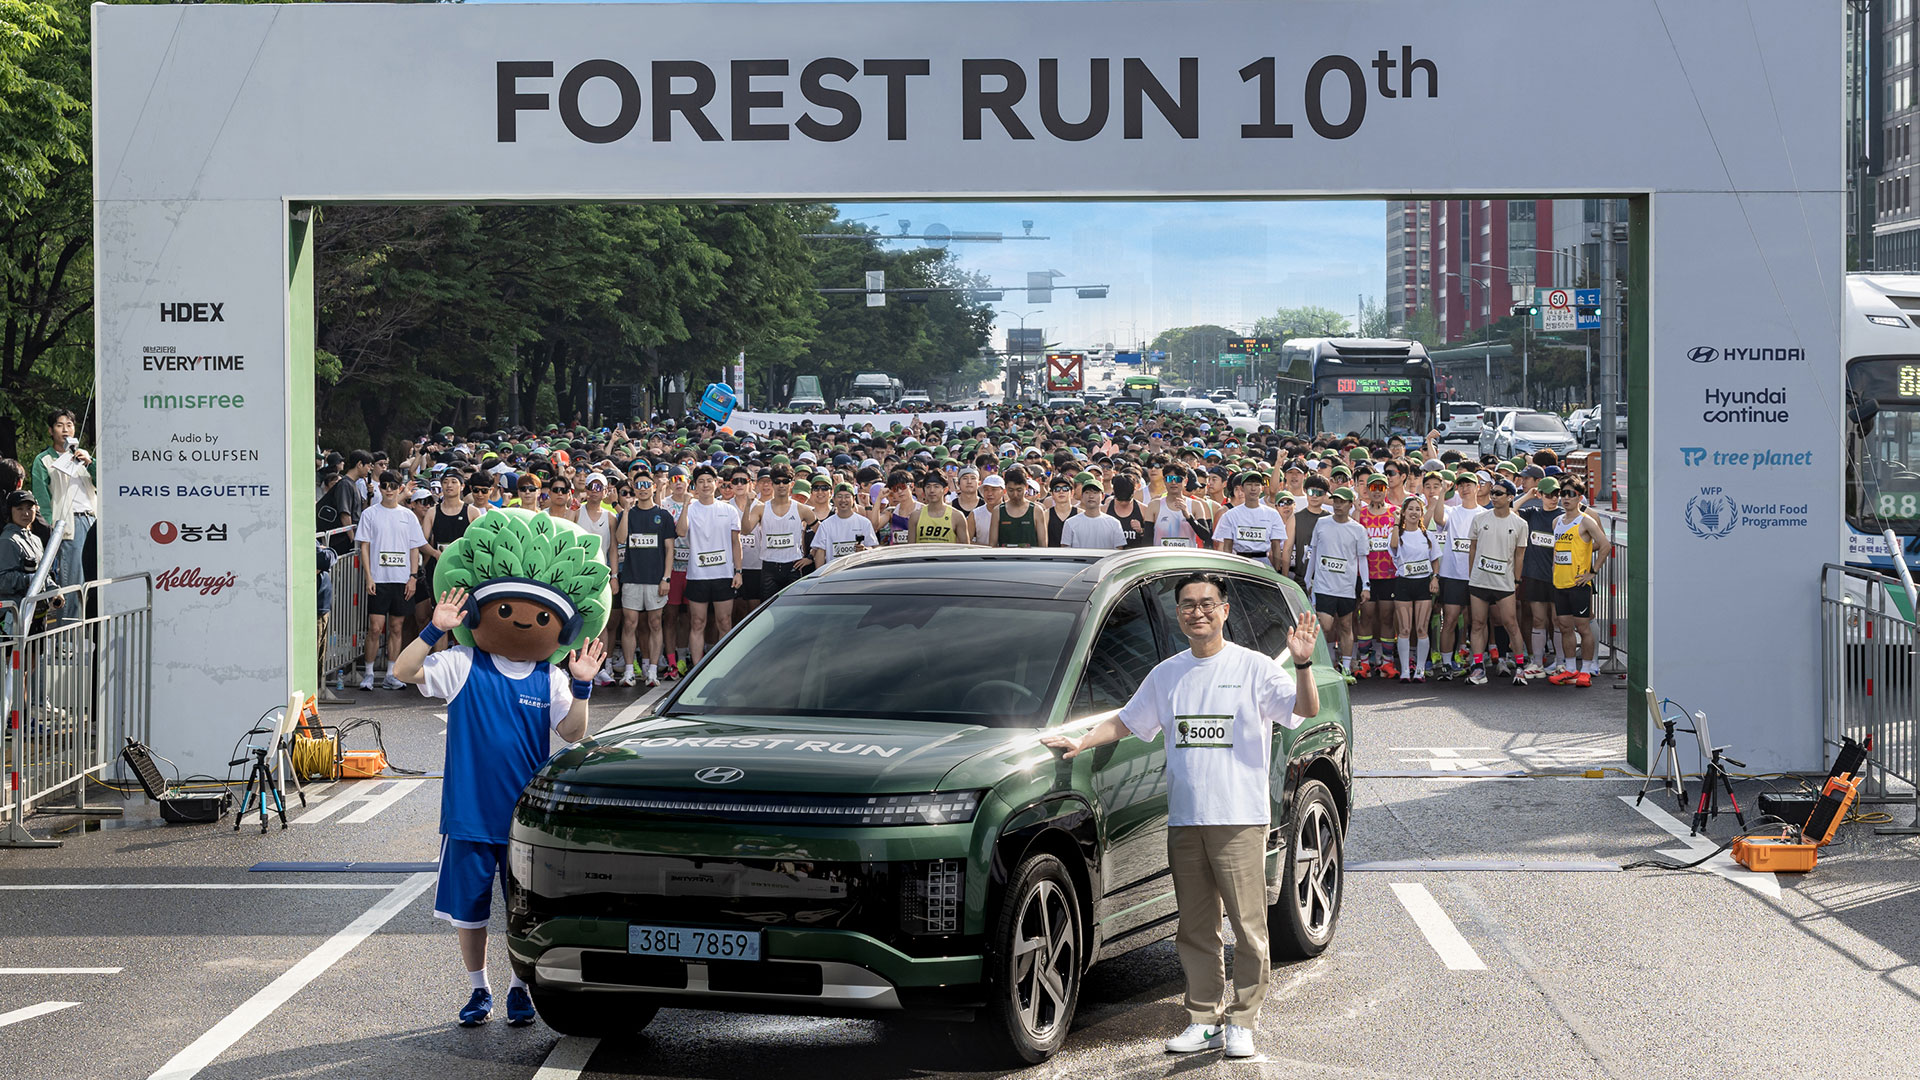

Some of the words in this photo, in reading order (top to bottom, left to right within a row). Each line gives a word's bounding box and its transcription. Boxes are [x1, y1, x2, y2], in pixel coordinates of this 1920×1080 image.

[495, 57, 931, 145] FOREST
[961, 55, 1201, 142] RUN
[1238, 45, 1439, 142] 10th
[1553, 294, 1565, 305] 50
[160, 302, 225, 323] HDEX
[143, 346, 177, 354] 에브리타임
[1724, 348, 1805, 361] HYUNDAI
[1337, 379, 1356, 392] 600
[1705, 387, 1786, 407] Hyundai
[1703, 407, 1789, 423] continue
[171, 433, 202, 443] Audio
[205, 433, 219, 446] by
[132, 450, 173, 462] BANG
[179, 450, 188, 462] &
[191, 450, 259, 462] OLUFSEN
[1713, 450, 1749, 466] tree
[1752, 449, 1813, 471] planet
[119, 485, 170, 497] PARIS
[177, 485, 270, 497] BAGUETTE
[1700, 487, 1723, 495] WFP
[1741, 504, 1777, 514] World
[1779, 504, 1808, 514] Food
[1742, 517, 1808, 529] Programme
[180, 523, 228, 542] 농심
[919, 526, 950, 537] 1987
[1245, 531, 1262, 539] 0231
[774, 538, 791, 546] 1189
[388, 556, 404, 564] 1276
[706, 555, 723, 564] 1093
[1327, 561, 1344, 570] 1027
[155, 566, 237, 596] Kellogg's
[1190, 726, 1225, 739] 5000
[613, 737, 795, 750] FOREST
[794, 740, 902, 758] RUN
[640, 929, 680, 953] 38다
[692, 932, 748, 957] 7859
